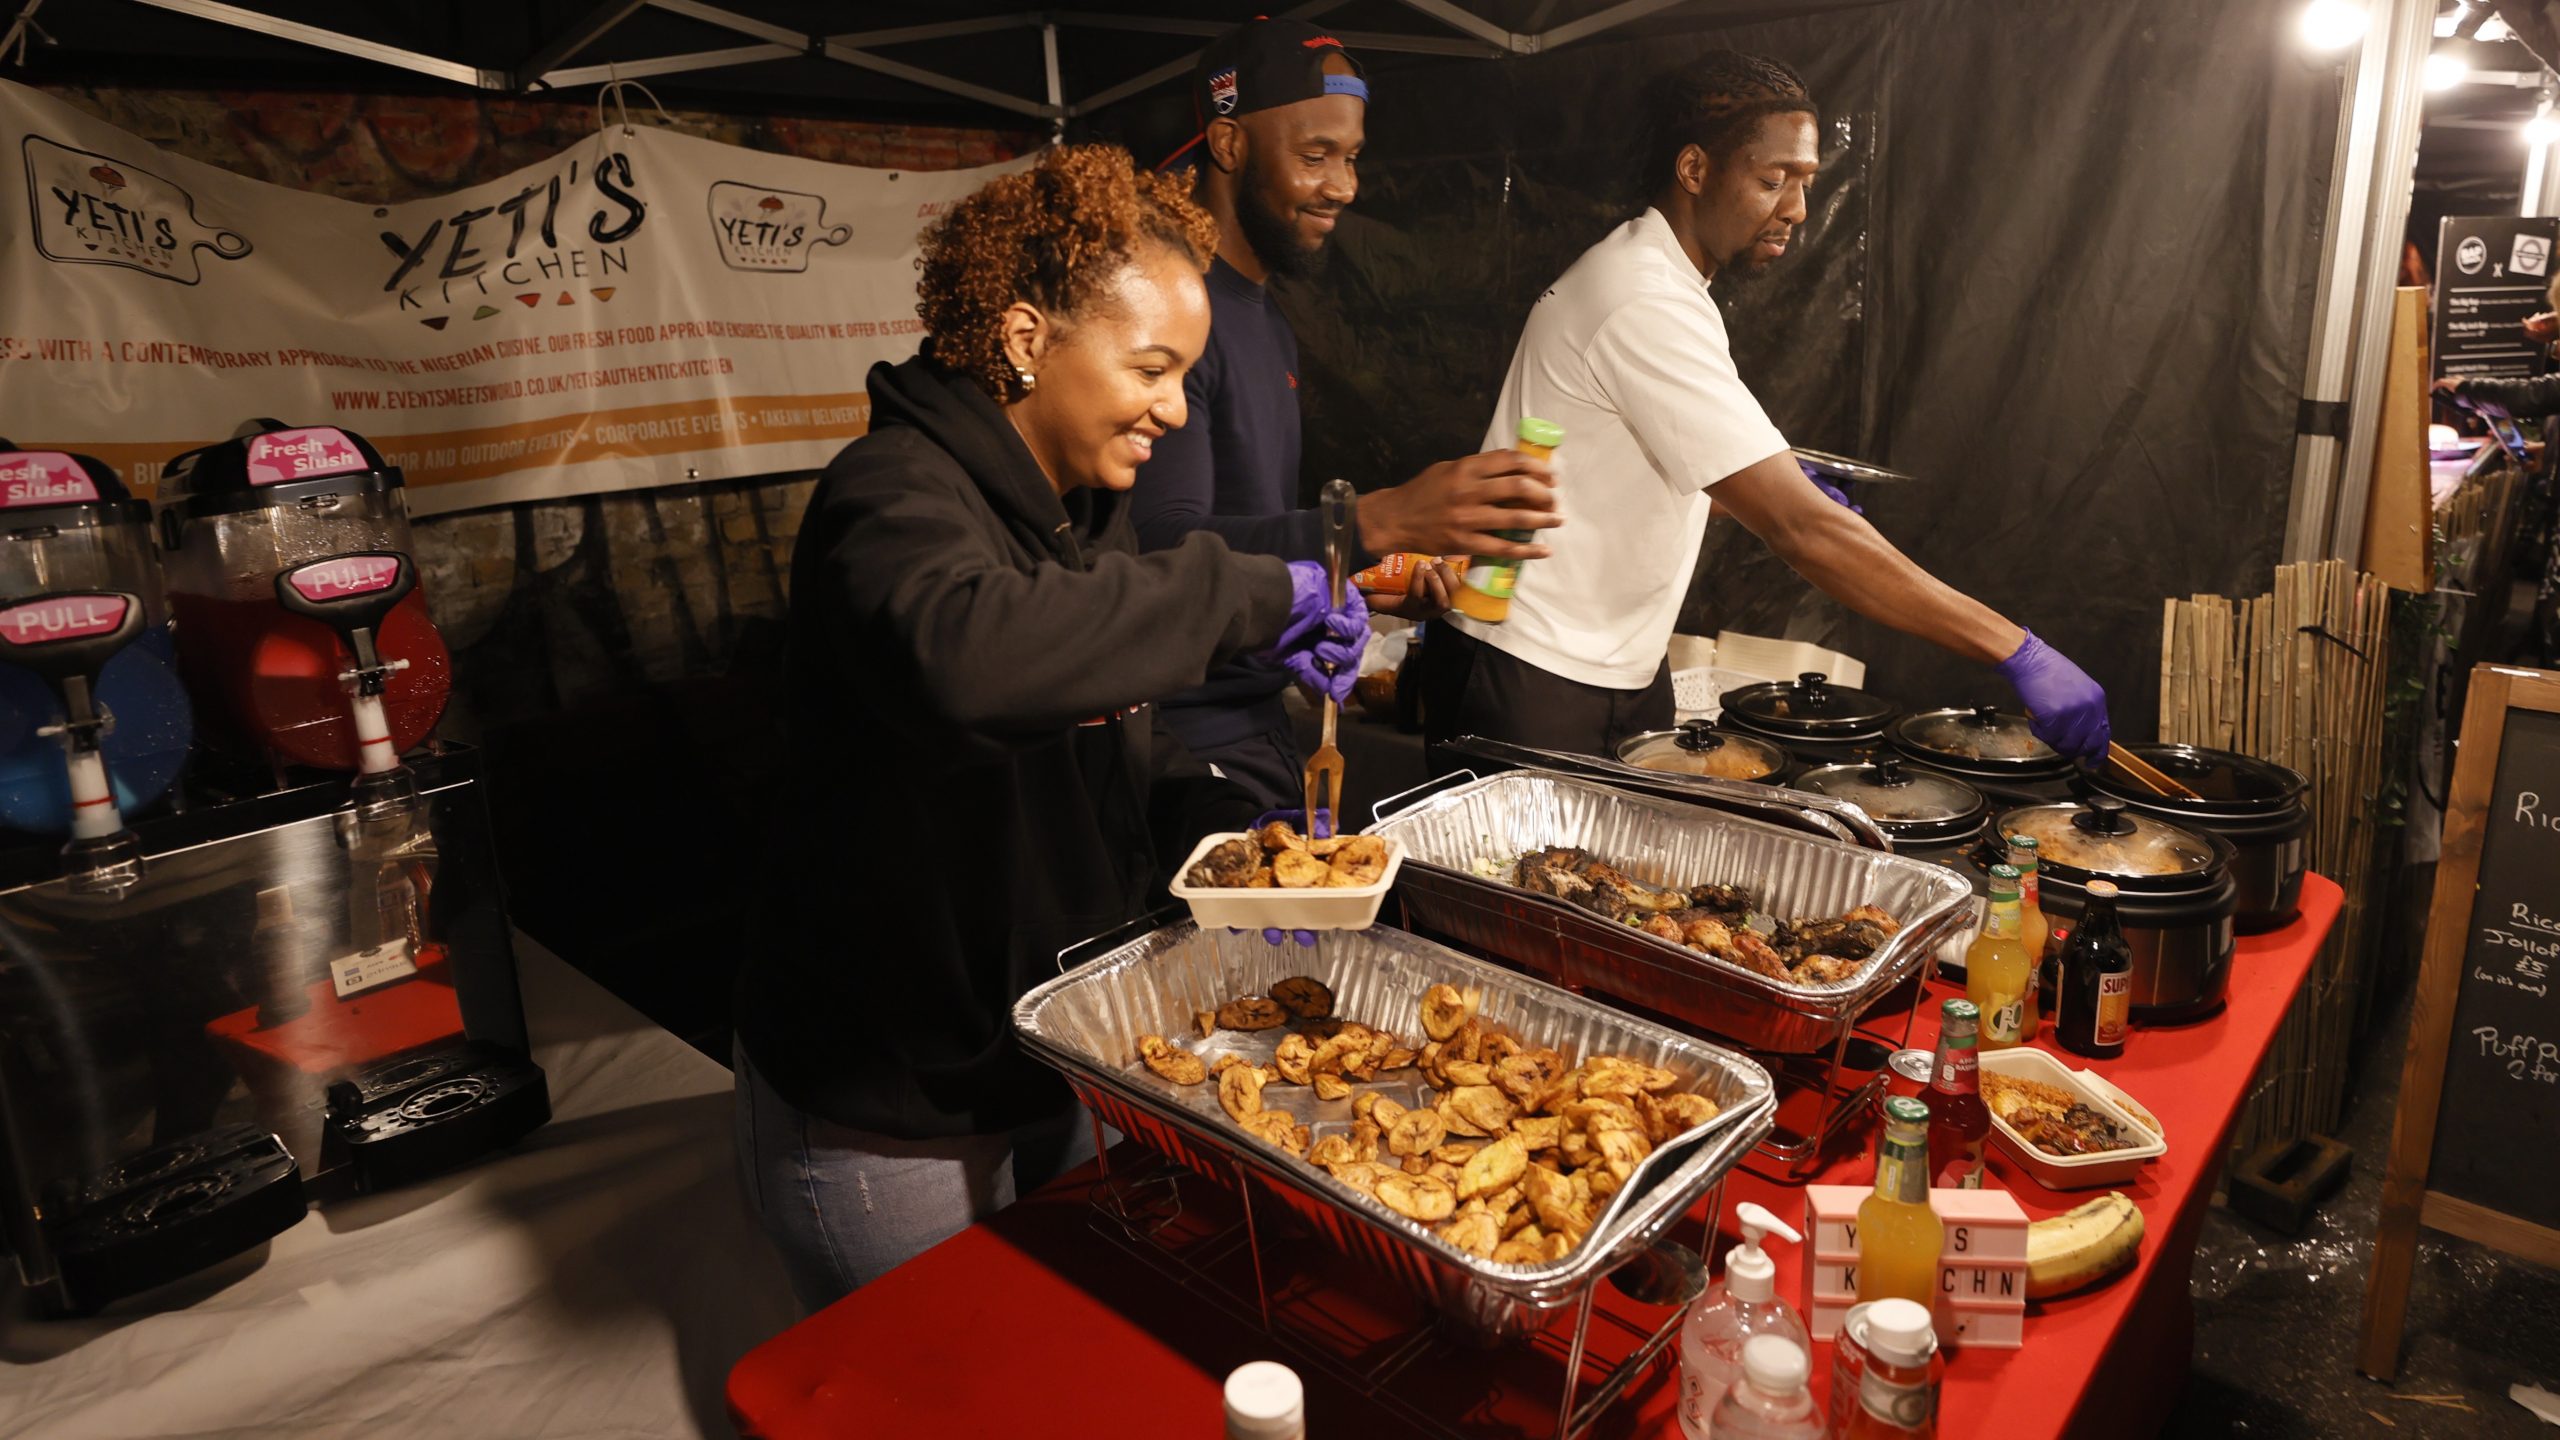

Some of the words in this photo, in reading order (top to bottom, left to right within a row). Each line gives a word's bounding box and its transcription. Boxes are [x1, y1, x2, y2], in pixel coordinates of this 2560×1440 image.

[51, 186, 178, 250] YETI'S
[380, 153, 647, 292] YETI'S
[720, 217, 804, 247] YETI'S
[76, 226, 174, 261] KITCHEN
[399, 246, 628, 311] KITCHEN
[37, 338, 93, 362] WITH
[102, 340, 115, 363] A
[121, 341, 273, 369] CONTEMPORARY
[278, 349, 366, 370] APPROACH
[366, 357, 388, 372] TO
[388, 359, 418, 375] THE
[421, 344, 496, 373] NIGERIAN
[548, 334, 571, 353] OUR
[572, 328, 614, 351] FRESH
[618, 325, 656, 346] FOOD
[659, 320, 726, 342] APPROACH
[726, 321, 769, 340] ENSURES
[768, 323, 785, 340] THE
[785, 323, 826, 341] QUALITY
[827, 322, 844, 339] WE
[846, 321, 876, 339] OFFER
[878, 320, 889, 336] IS
[260, 437, 324, 460] Fresh
[423, 447, 457, 471] AND
[461, 438, 525, 466] OUTDOOR
[527, 428, 575, 455] EVENTS
[595, 415, 690, 446] CORPORATE
[760, 408, 810, 428] TAKEAWAY
[812, 405, 860, 426] DELIVERY
[293, 452, 354, 473] Slush
[7, 480, 82, 500] Slush
[313, 562, 387, 593] PULL
[16, 603, 109, 636] PULL
[2511, 902, 2560, 932] Rice
[2483, 928, 2560, 959] Jollof
[2515, 955, 2550, 973] £5
[2103, 976, 2130, 994] SUP
[2507, 1059, 2526, 1081] 2
